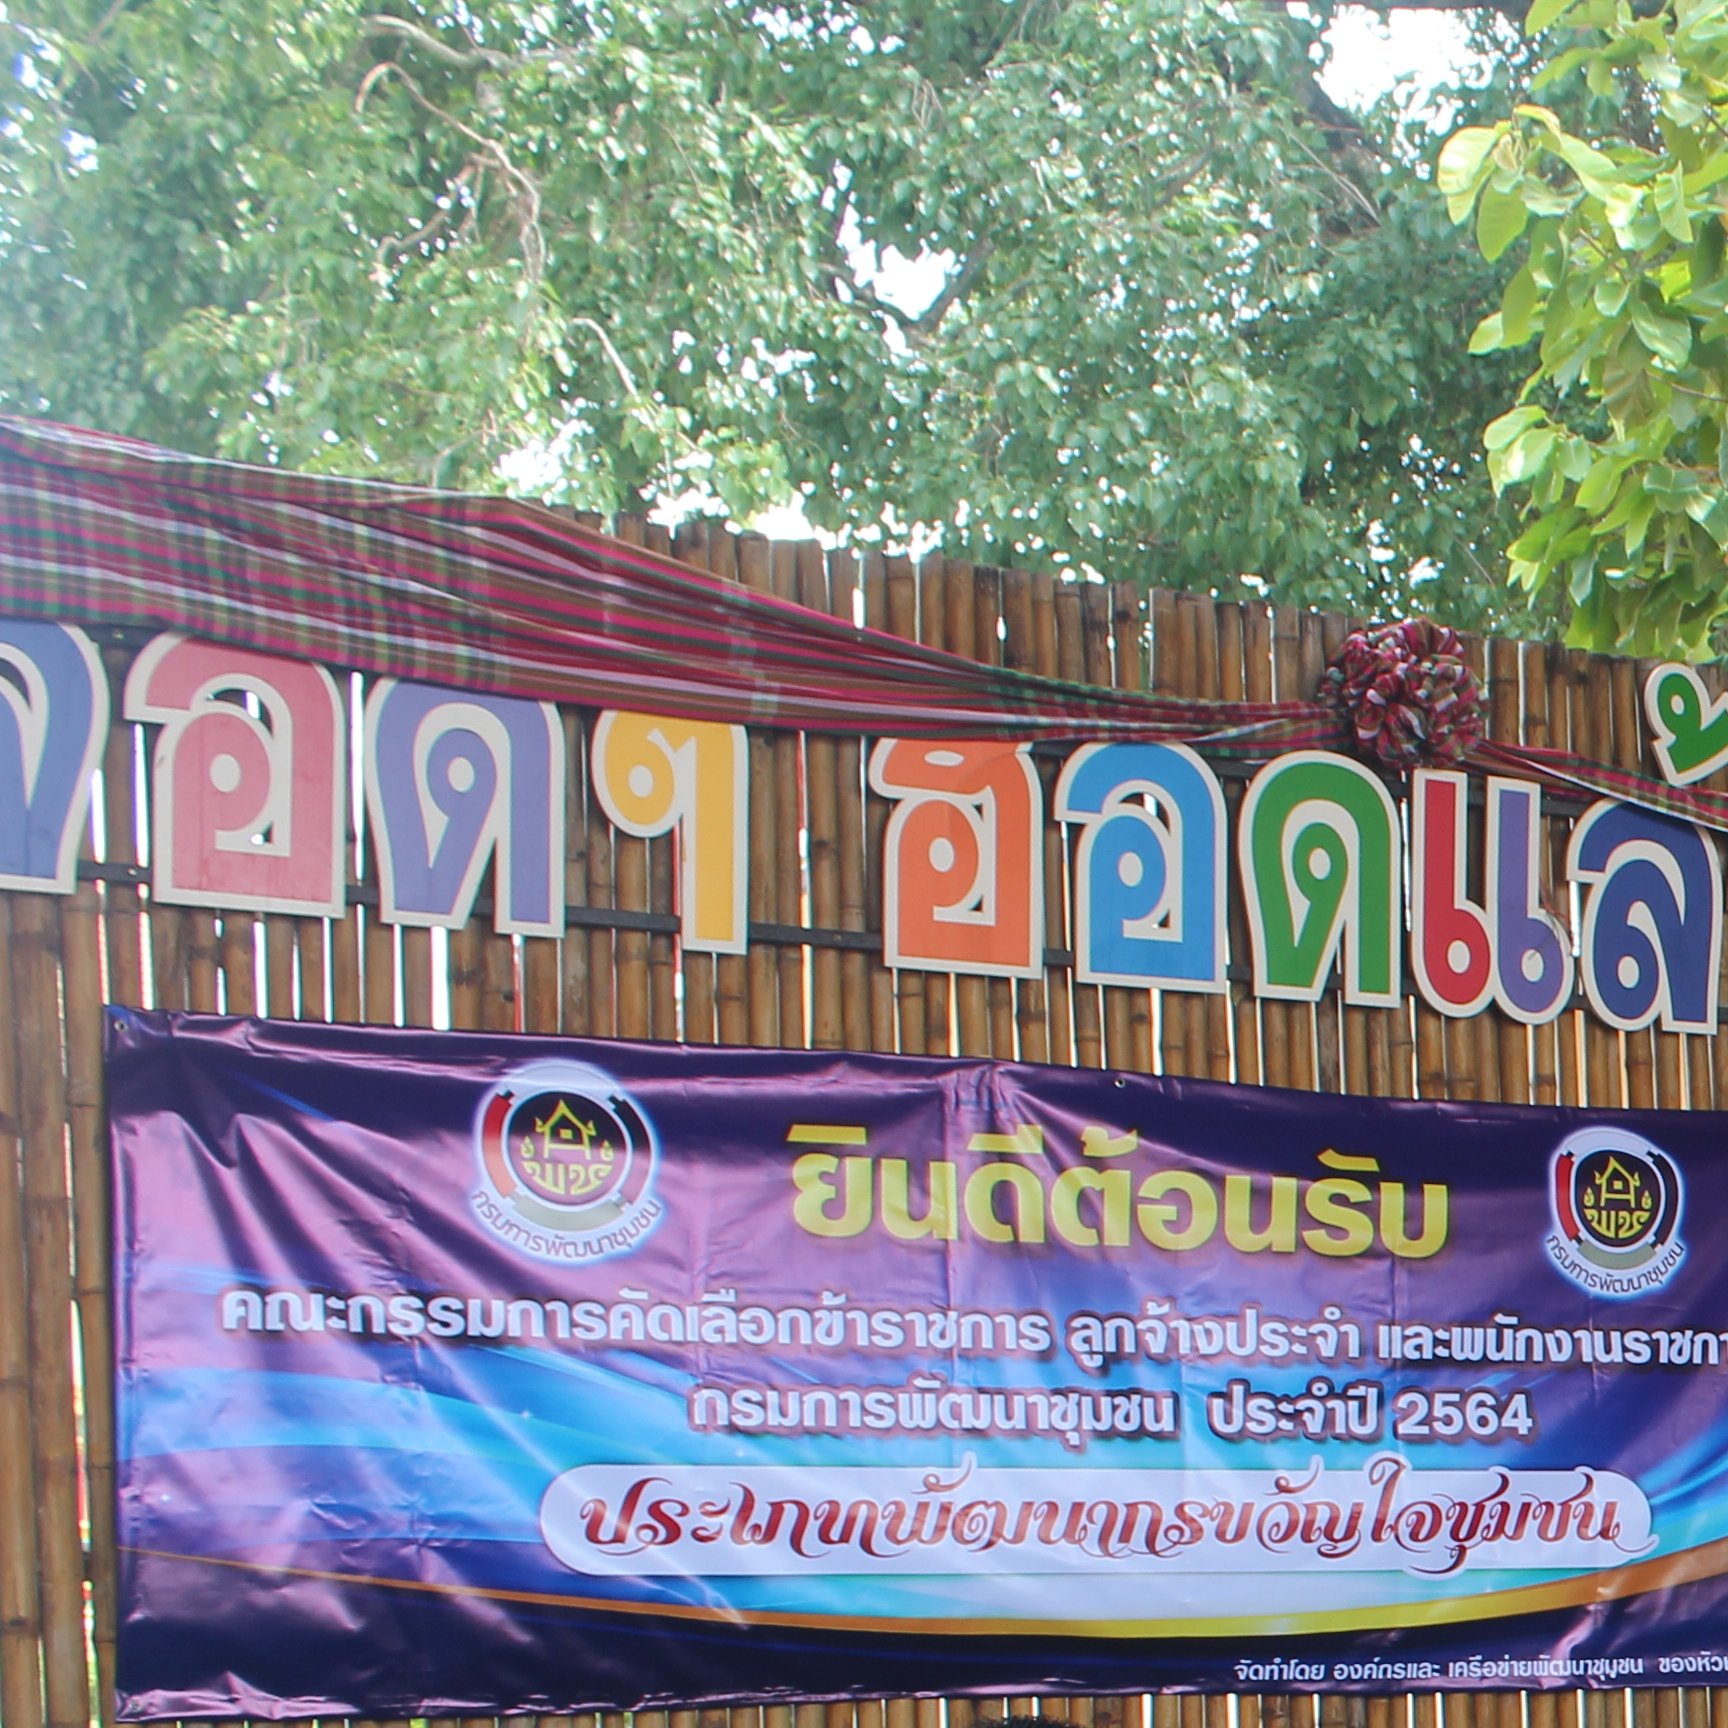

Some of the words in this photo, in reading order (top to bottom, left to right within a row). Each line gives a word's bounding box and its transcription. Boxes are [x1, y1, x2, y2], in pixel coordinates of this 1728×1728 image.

[470, 1190, 663, 1259] กรมการพัฒนาชุมชน
[786, 1123, 1449, 1259] ยินดีต้อนรับ
[1546, 1234, 1686, 1294] กรมการพัฒนาชุมชน
[221, 1285, 1052, 1352] คณะกรรมการคัดเลือกข้าราชการ
[1069, 1304, 1361, 1372] ลูกจ้างประจำ
[692, 1377, 1176, 1450] กรมการพัฒนาชุมชน
[1209, 1384, 1379, 1437] ประจำปี
[1396, 1391, 1534, 1438] 2564
[578, 1456, 1625, 1574] ประเภทพัฒนากรขวัญใจชุมชน
[1233, 1657, 1325, 1682] จัดทำโดย
[1334, 1656, 1440, 1681] องค์กรและ
[1448, 1652, 1644, 1682] เครือข่ายพัฒนาชุมชน
